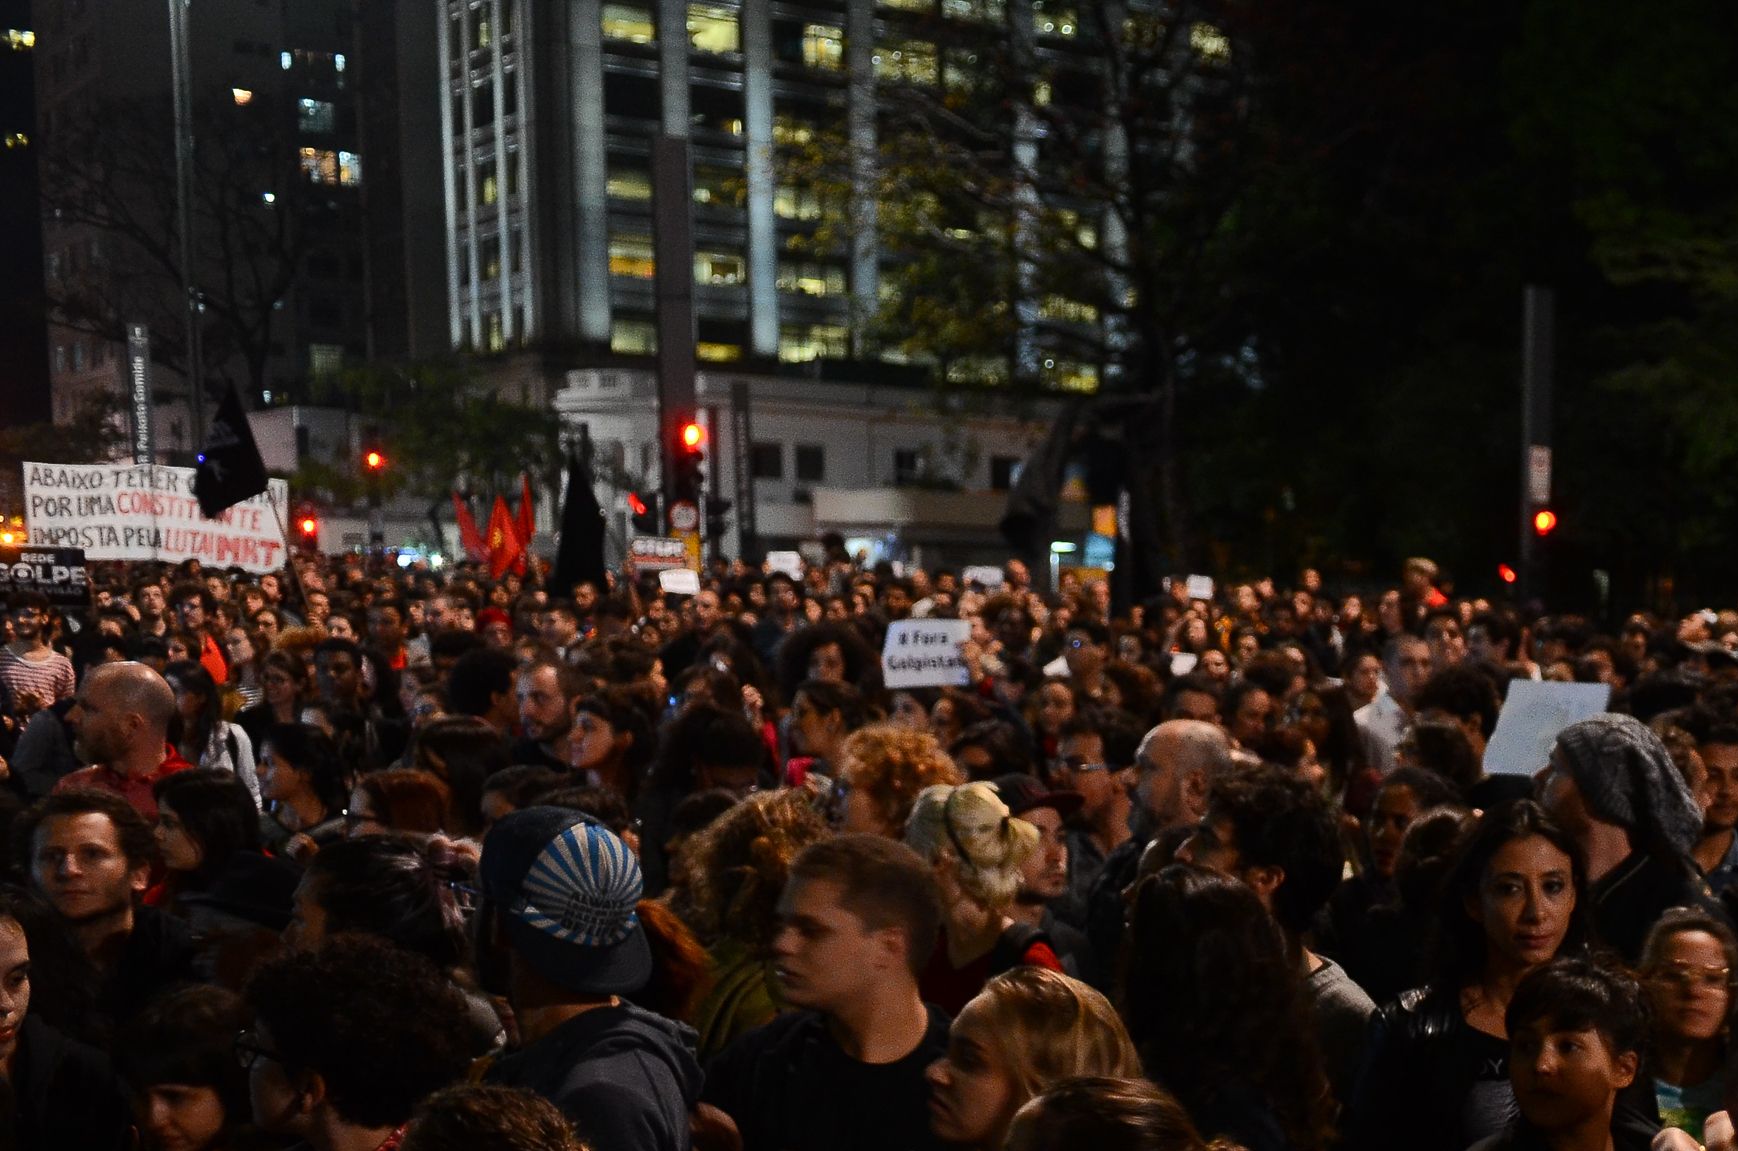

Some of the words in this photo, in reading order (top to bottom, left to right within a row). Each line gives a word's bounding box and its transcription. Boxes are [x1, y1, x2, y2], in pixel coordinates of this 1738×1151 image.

[112, 469, 178, 492] TEMER
[32, 495, 72, 517] POR
[78, 495, 115, 517] UMA
[117, 491, 261, 531] CONSTITNTE
